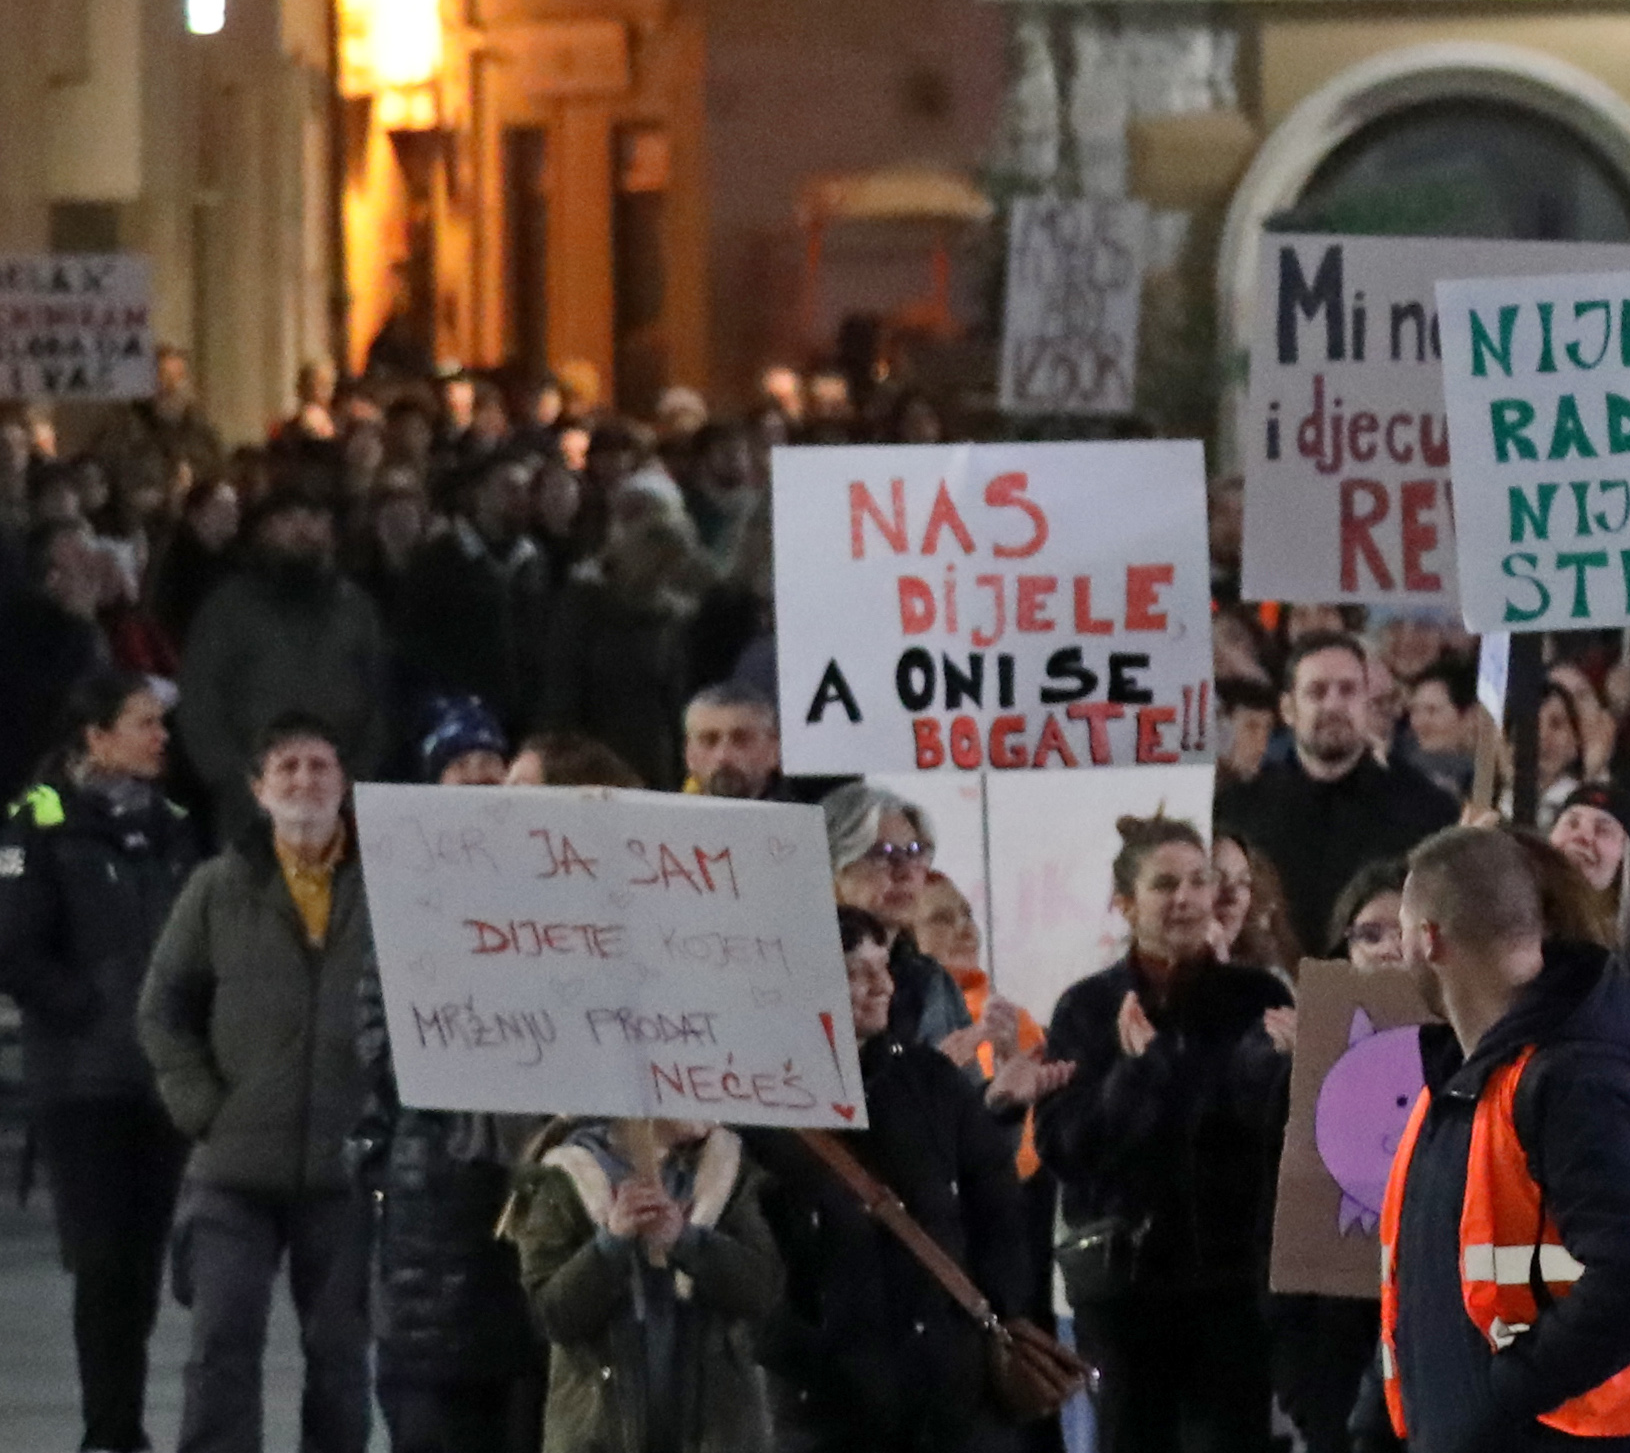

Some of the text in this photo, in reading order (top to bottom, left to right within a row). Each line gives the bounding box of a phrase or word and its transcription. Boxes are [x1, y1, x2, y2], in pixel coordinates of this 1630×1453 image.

[1277, 244, 1366, 365] Mi
[1266, 401, 1281, 461] i
[848, 471, 1050, 559] NAS
[1339, 477, 1455, 592] RE
[806, 645, 1154, 724] A ONI SE
[912, 679, 1210, 770] BOGATE!!
[529, 828, 598, 881] JA
[627, 839, 740, 899] SAM
[462, 918, 624, 959] DIJETE
[585, 1006, 718, 1048] PRODAT
